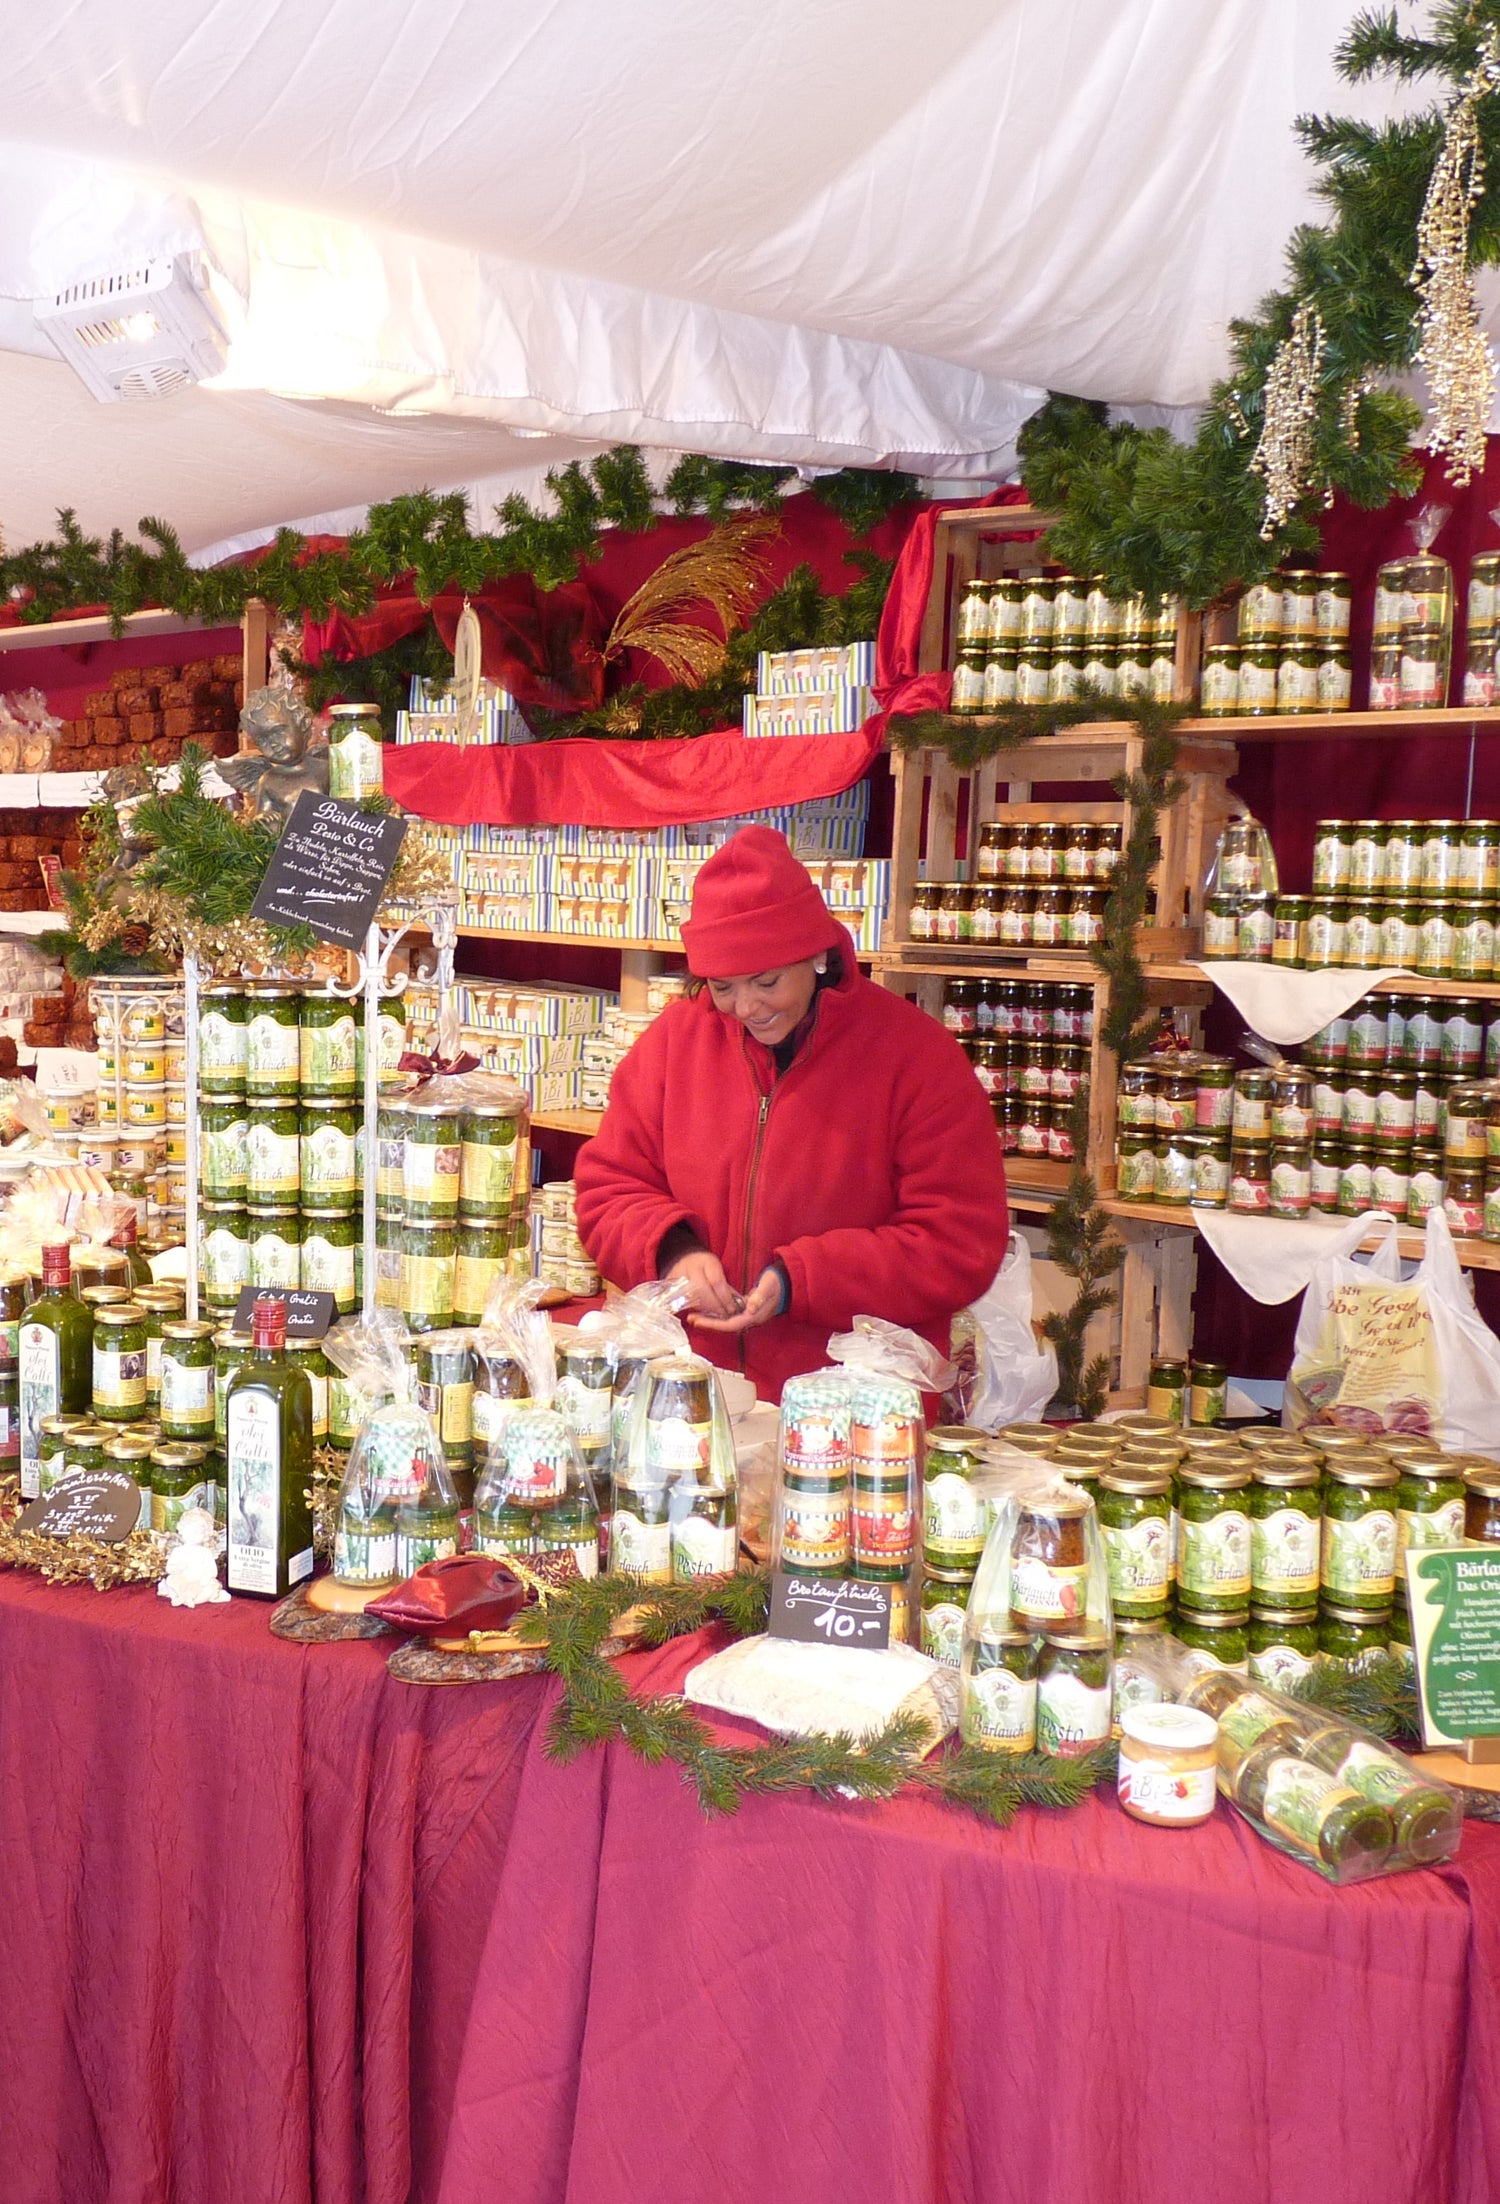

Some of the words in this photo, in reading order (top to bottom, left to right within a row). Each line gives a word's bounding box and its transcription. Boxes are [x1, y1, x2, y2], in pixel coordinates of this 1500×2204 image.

[312, 802, 386, 838] Bärlauch
[310, 822, 341, 841] Pesto
[343, 833, 356, 847] &
[359, 837, 375, 851] Co
[568, 1005, 586, 1023] iBi
[551, 1042, 569, 1062] iBi
[543, 1080, 561, 1099] iBi
[289, 1293, 319, 1305] Gratis
[287, 1313, 315, 1324] Gratis
[926, 1516, 977, 1539] Bäauch
[240, 1547, 265, 1557] OLIO
[618, 1559, 649, 1574] rlauch
[676, 1553, 713, 1575] Pesto
[788, 1580, 886, 1605] Brotaufstriche
[1456, 1581, 1479, 1592] Das
[971, 1713, 1025, 1738] Bärlauch
[1041, 1716, 1084, 1743] Pesto
